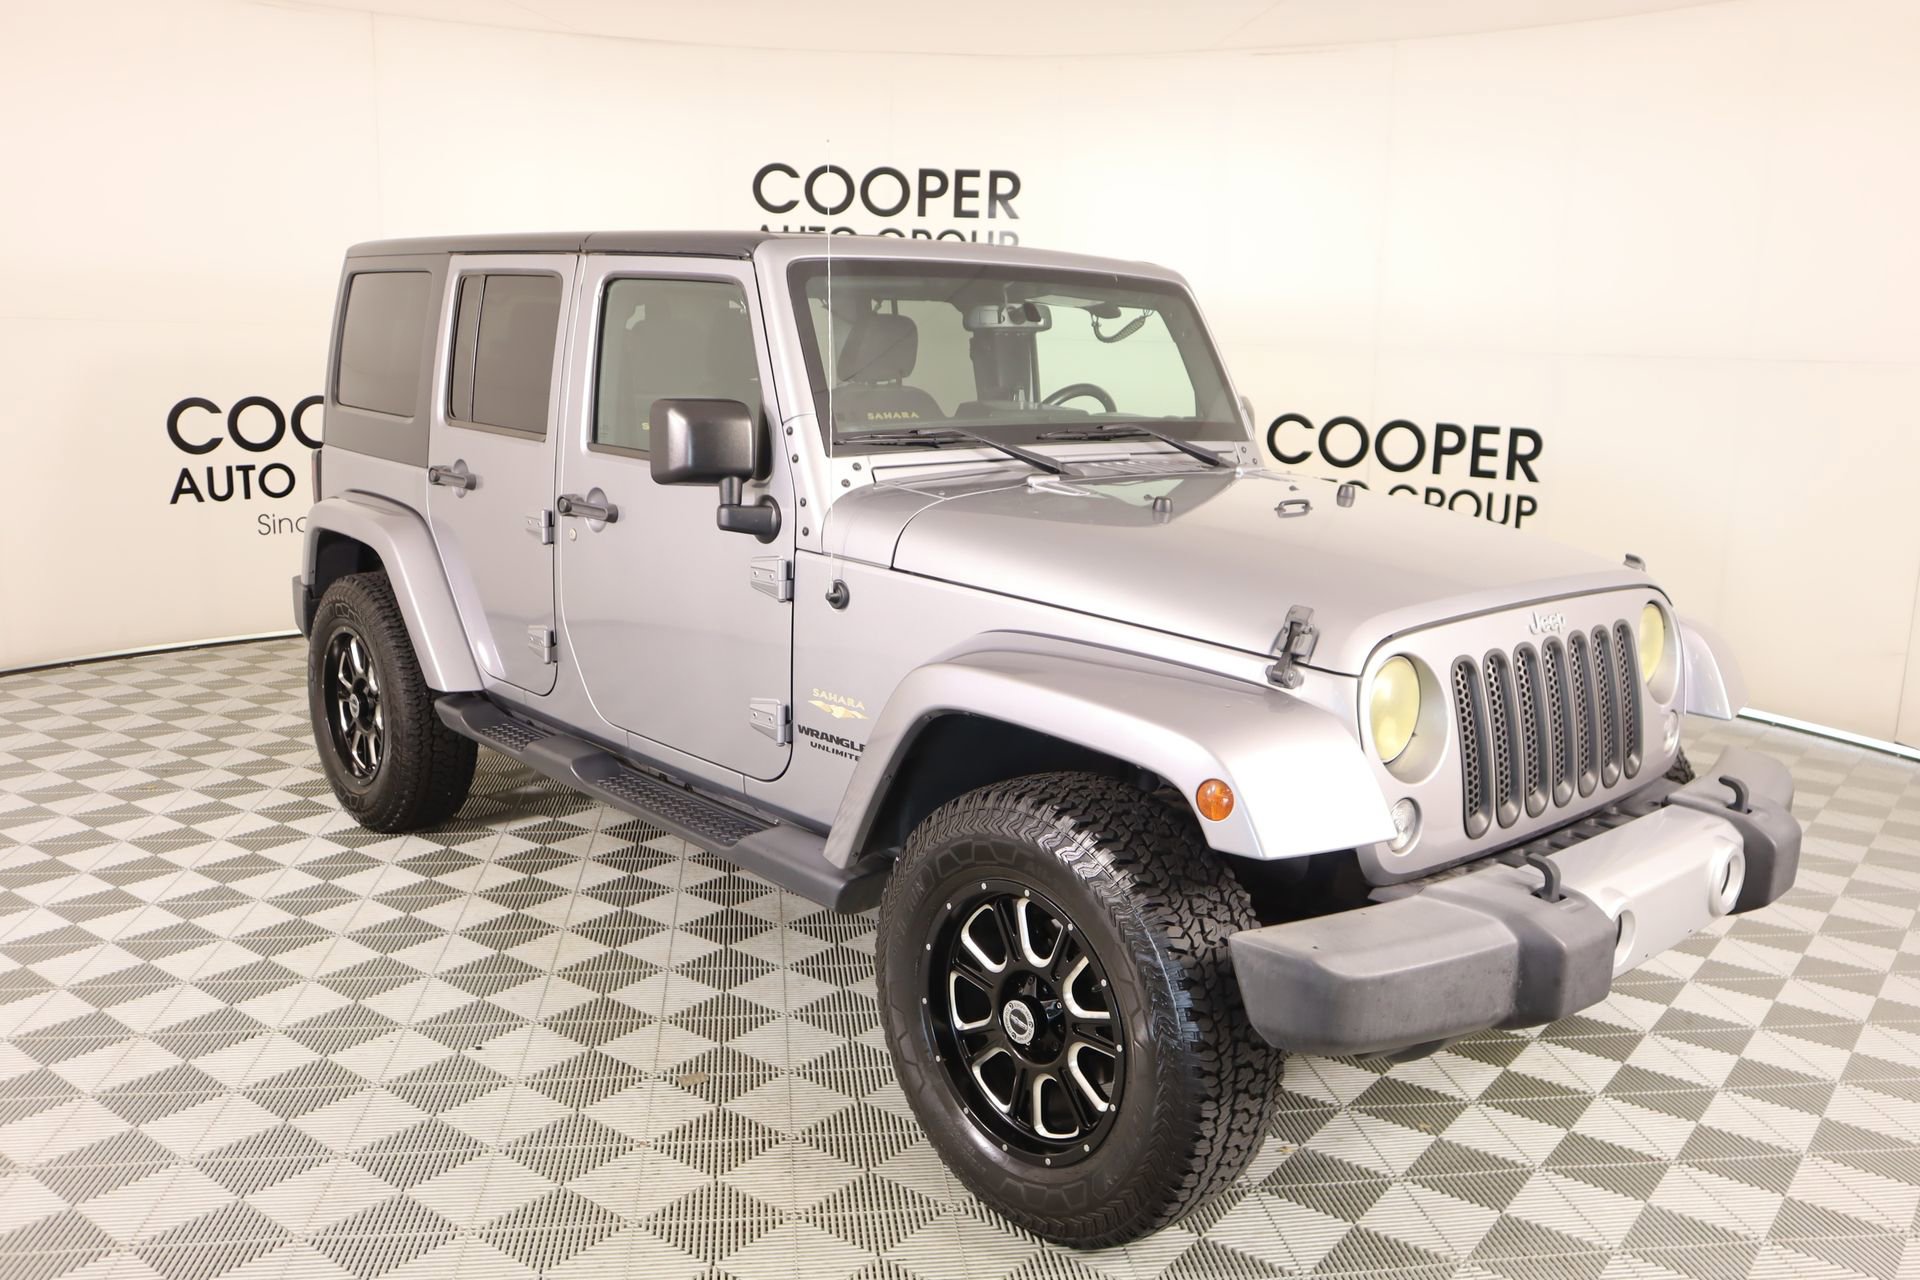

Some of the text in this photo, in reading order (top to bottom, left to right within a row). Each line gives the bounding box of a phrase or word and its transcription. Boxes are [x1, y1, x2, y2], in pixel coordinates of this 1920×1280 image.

[753, 163, 1021, 219] COOPER
[866, 411, 919, 420] SAHARA
[1267, 412, 1543, 483] COOPER
[170, 462, 296, 505] AUTO
[1529, 610, 1566, 635] Jeep
[812, 687, 865, 711] SAHARA
